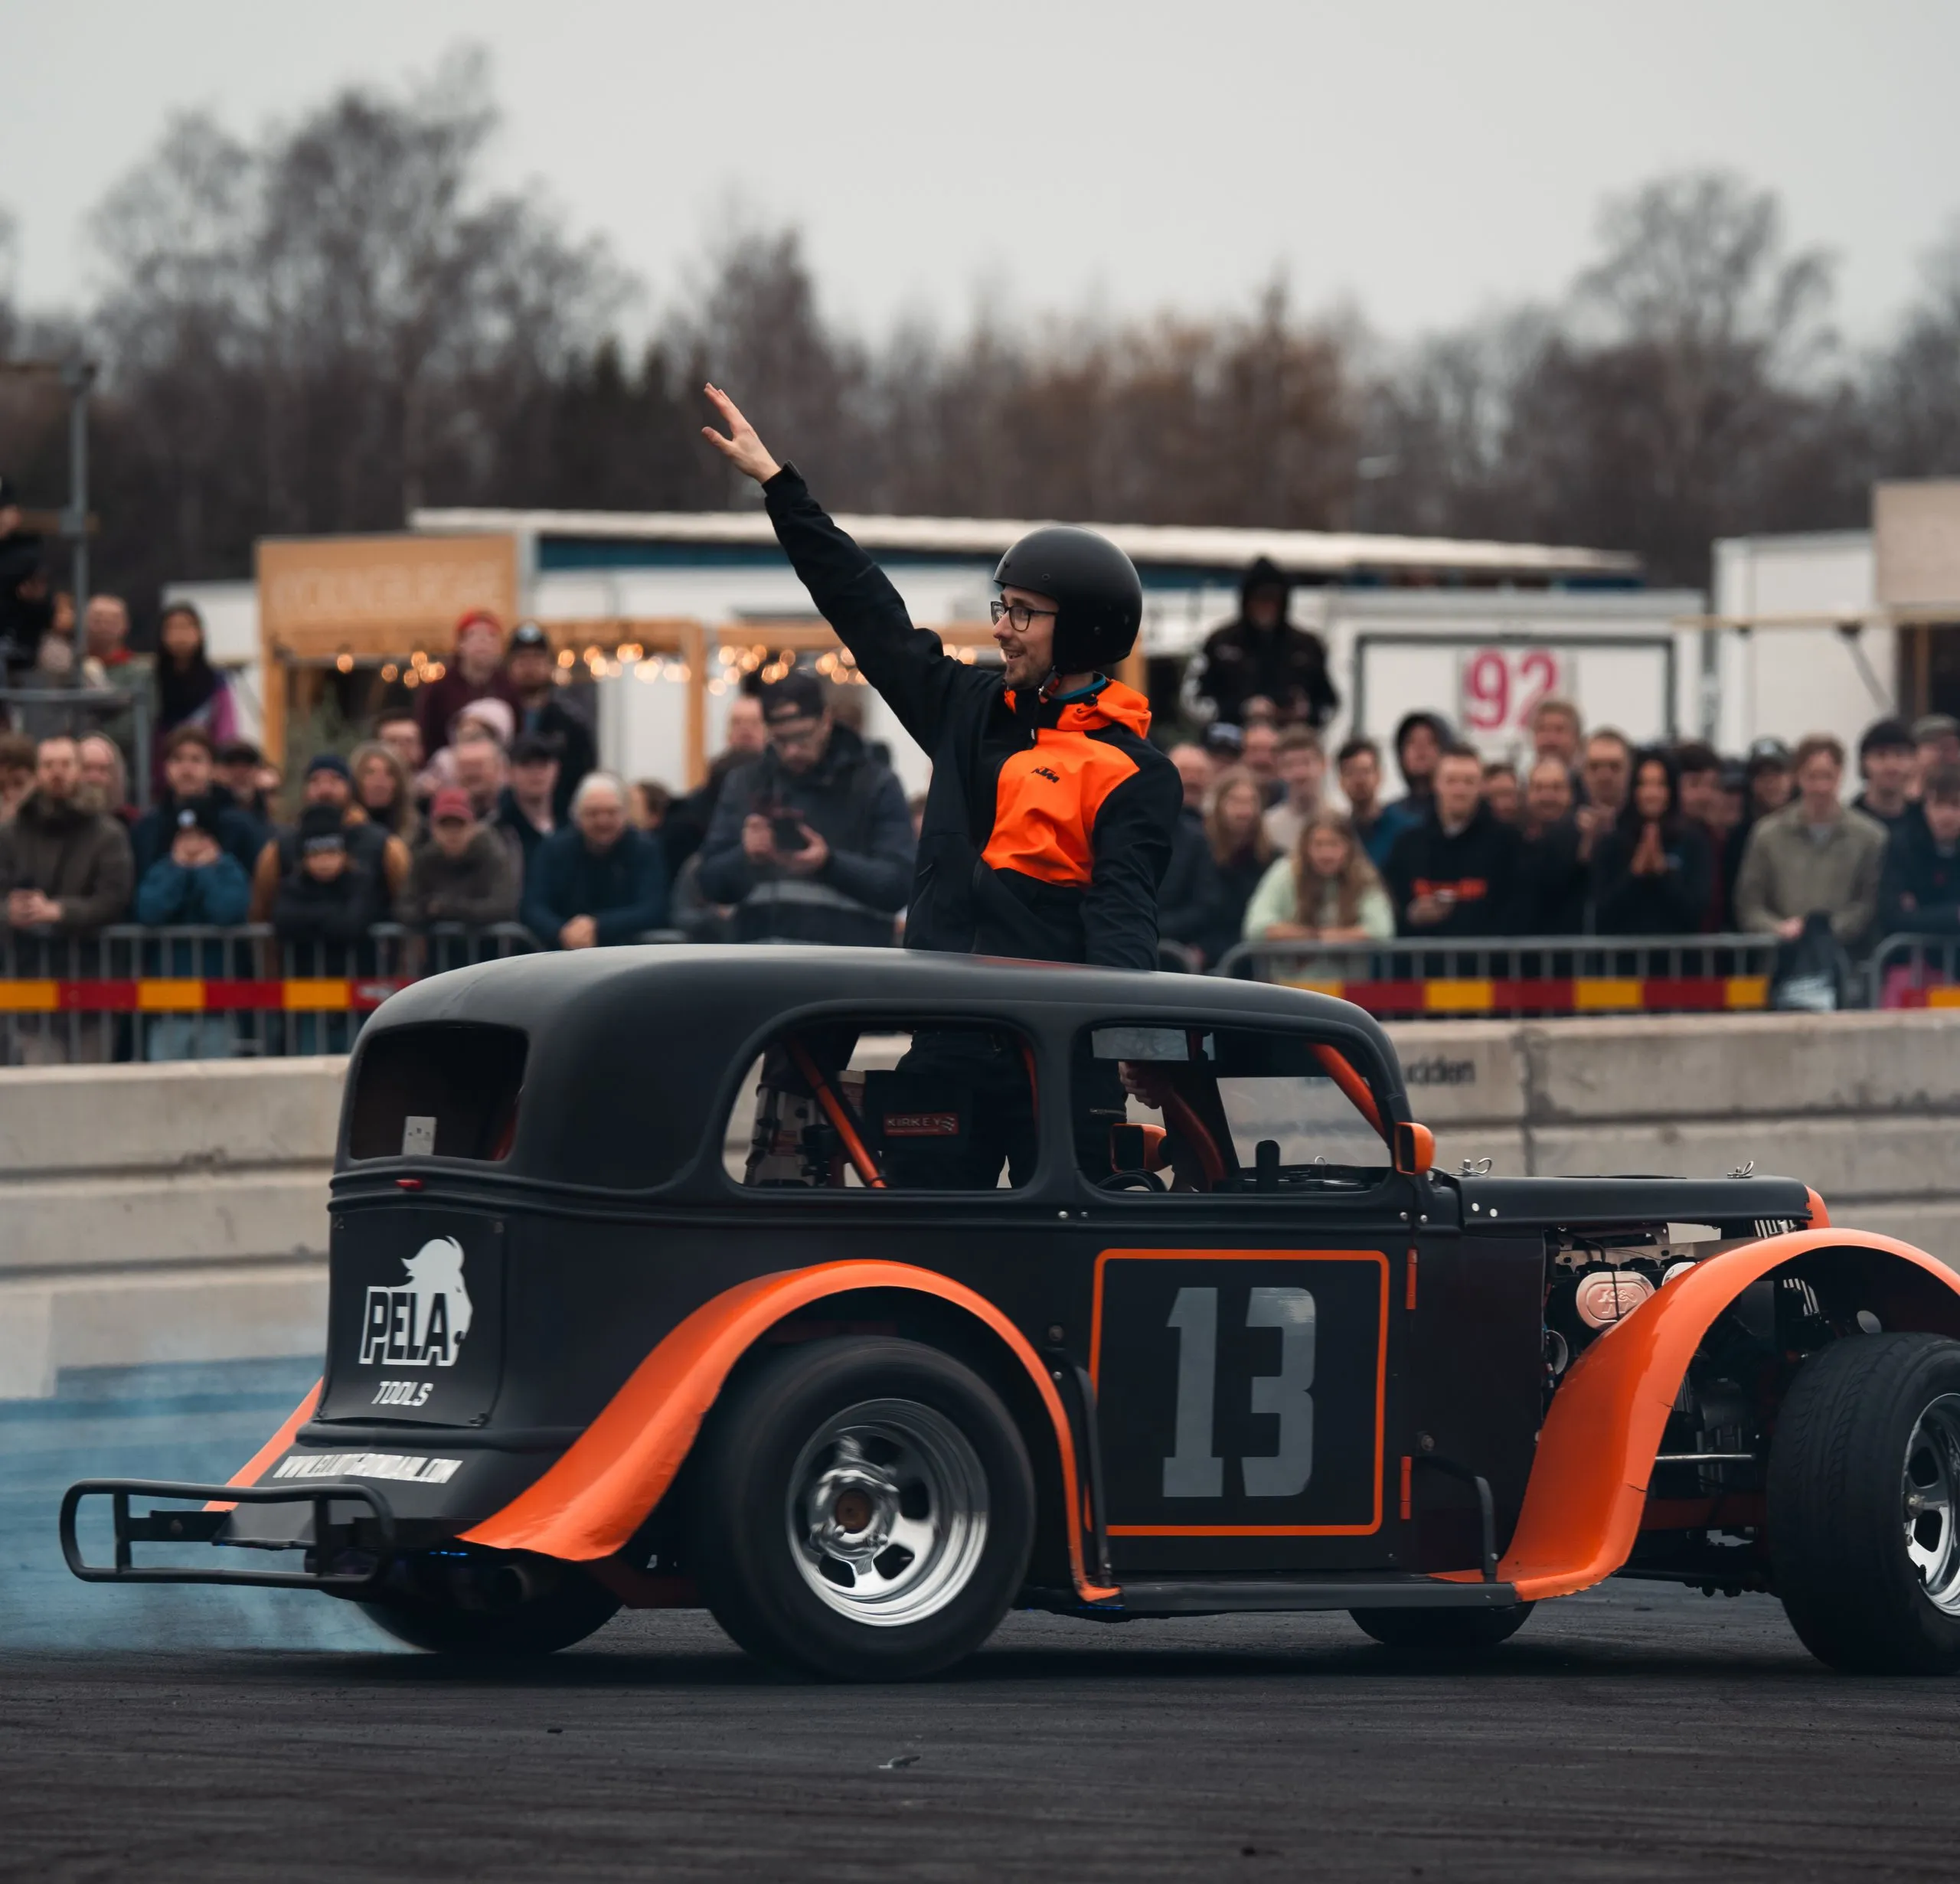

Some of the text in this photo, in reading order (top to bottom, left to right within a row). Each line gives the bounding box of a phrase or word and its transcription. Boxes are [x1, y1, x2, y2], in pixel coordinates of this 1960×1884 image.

[1464, 647, 1557, 730] 92
[1031, 766, 1060, 783] KTM
[887, 1117, 941, 1127] KIRKEY
[359, 1286, 457, 1366] PELA
[371, 1381, 433, 1406] TOOLS
[1162, 1287, 1316, 1497] 13
